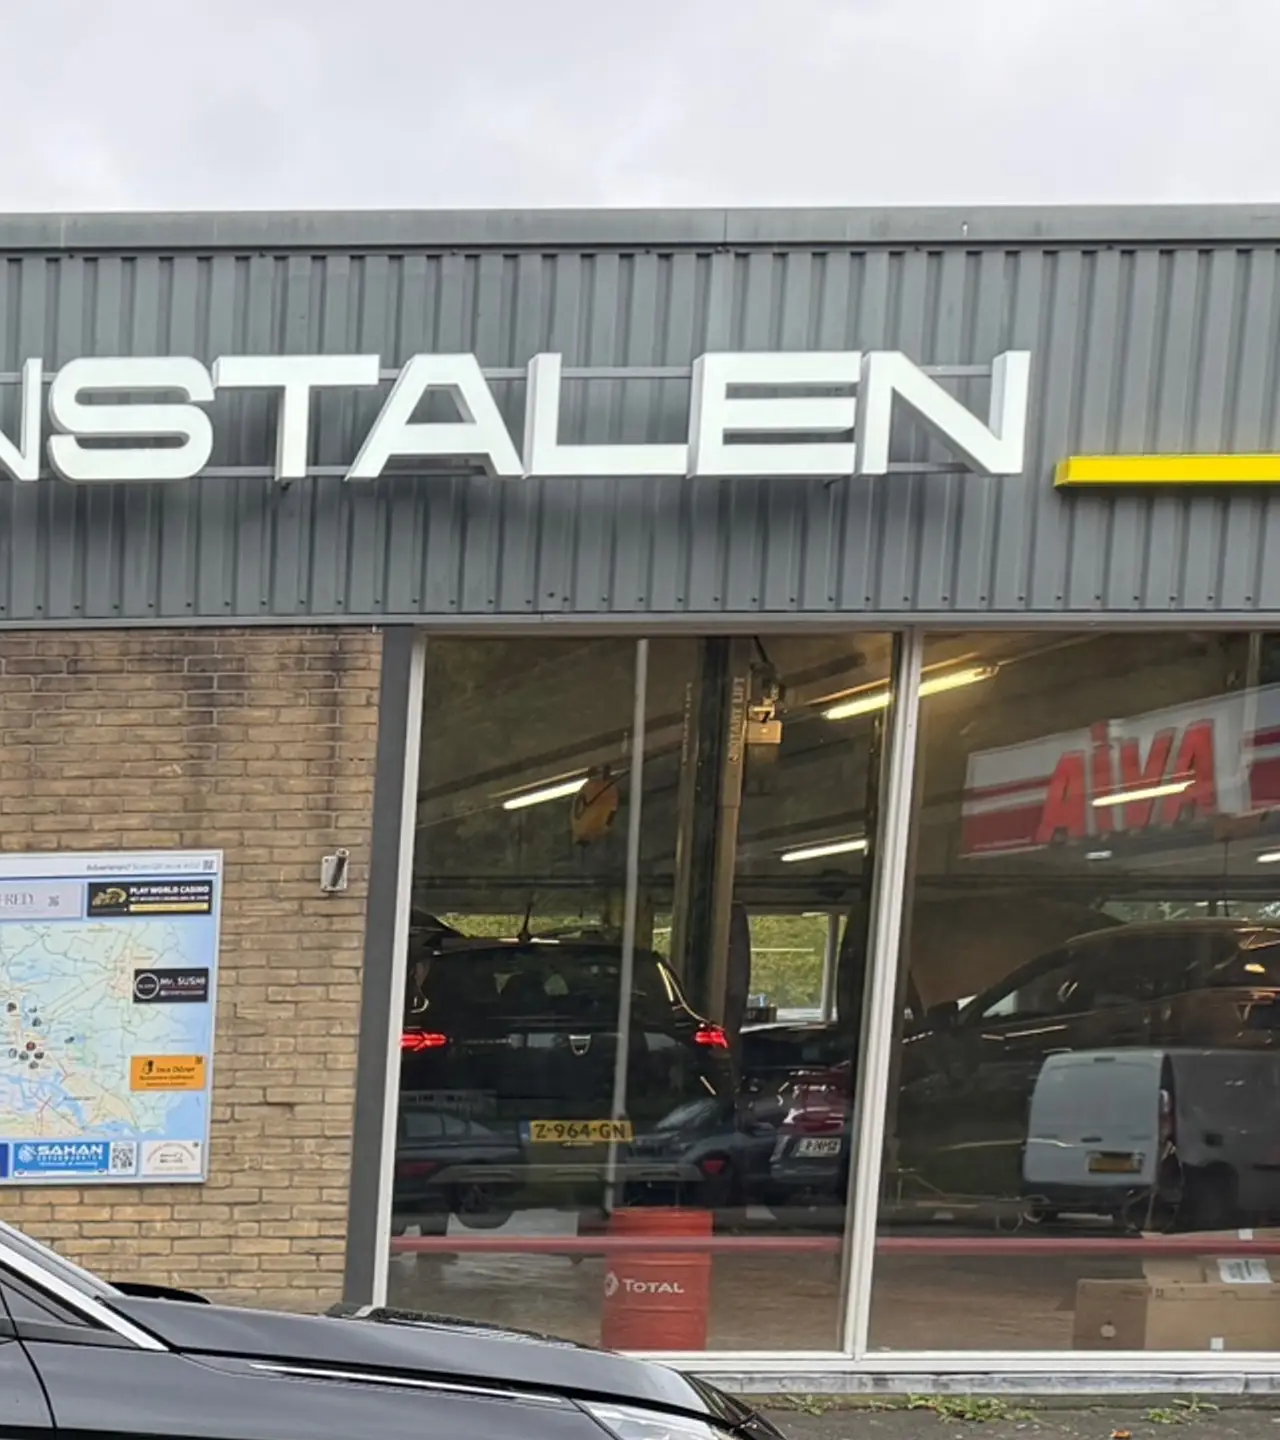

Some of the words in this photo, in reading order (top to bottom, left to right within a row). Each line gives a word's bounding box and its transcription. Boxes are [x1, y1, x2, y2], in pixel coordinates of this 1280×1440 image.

[534, 1122, 626, 1140] Z-964-GN
[37, 1144, 104, 1155] SAHAN
[621, 1278, 686, 1294] TOTAL
